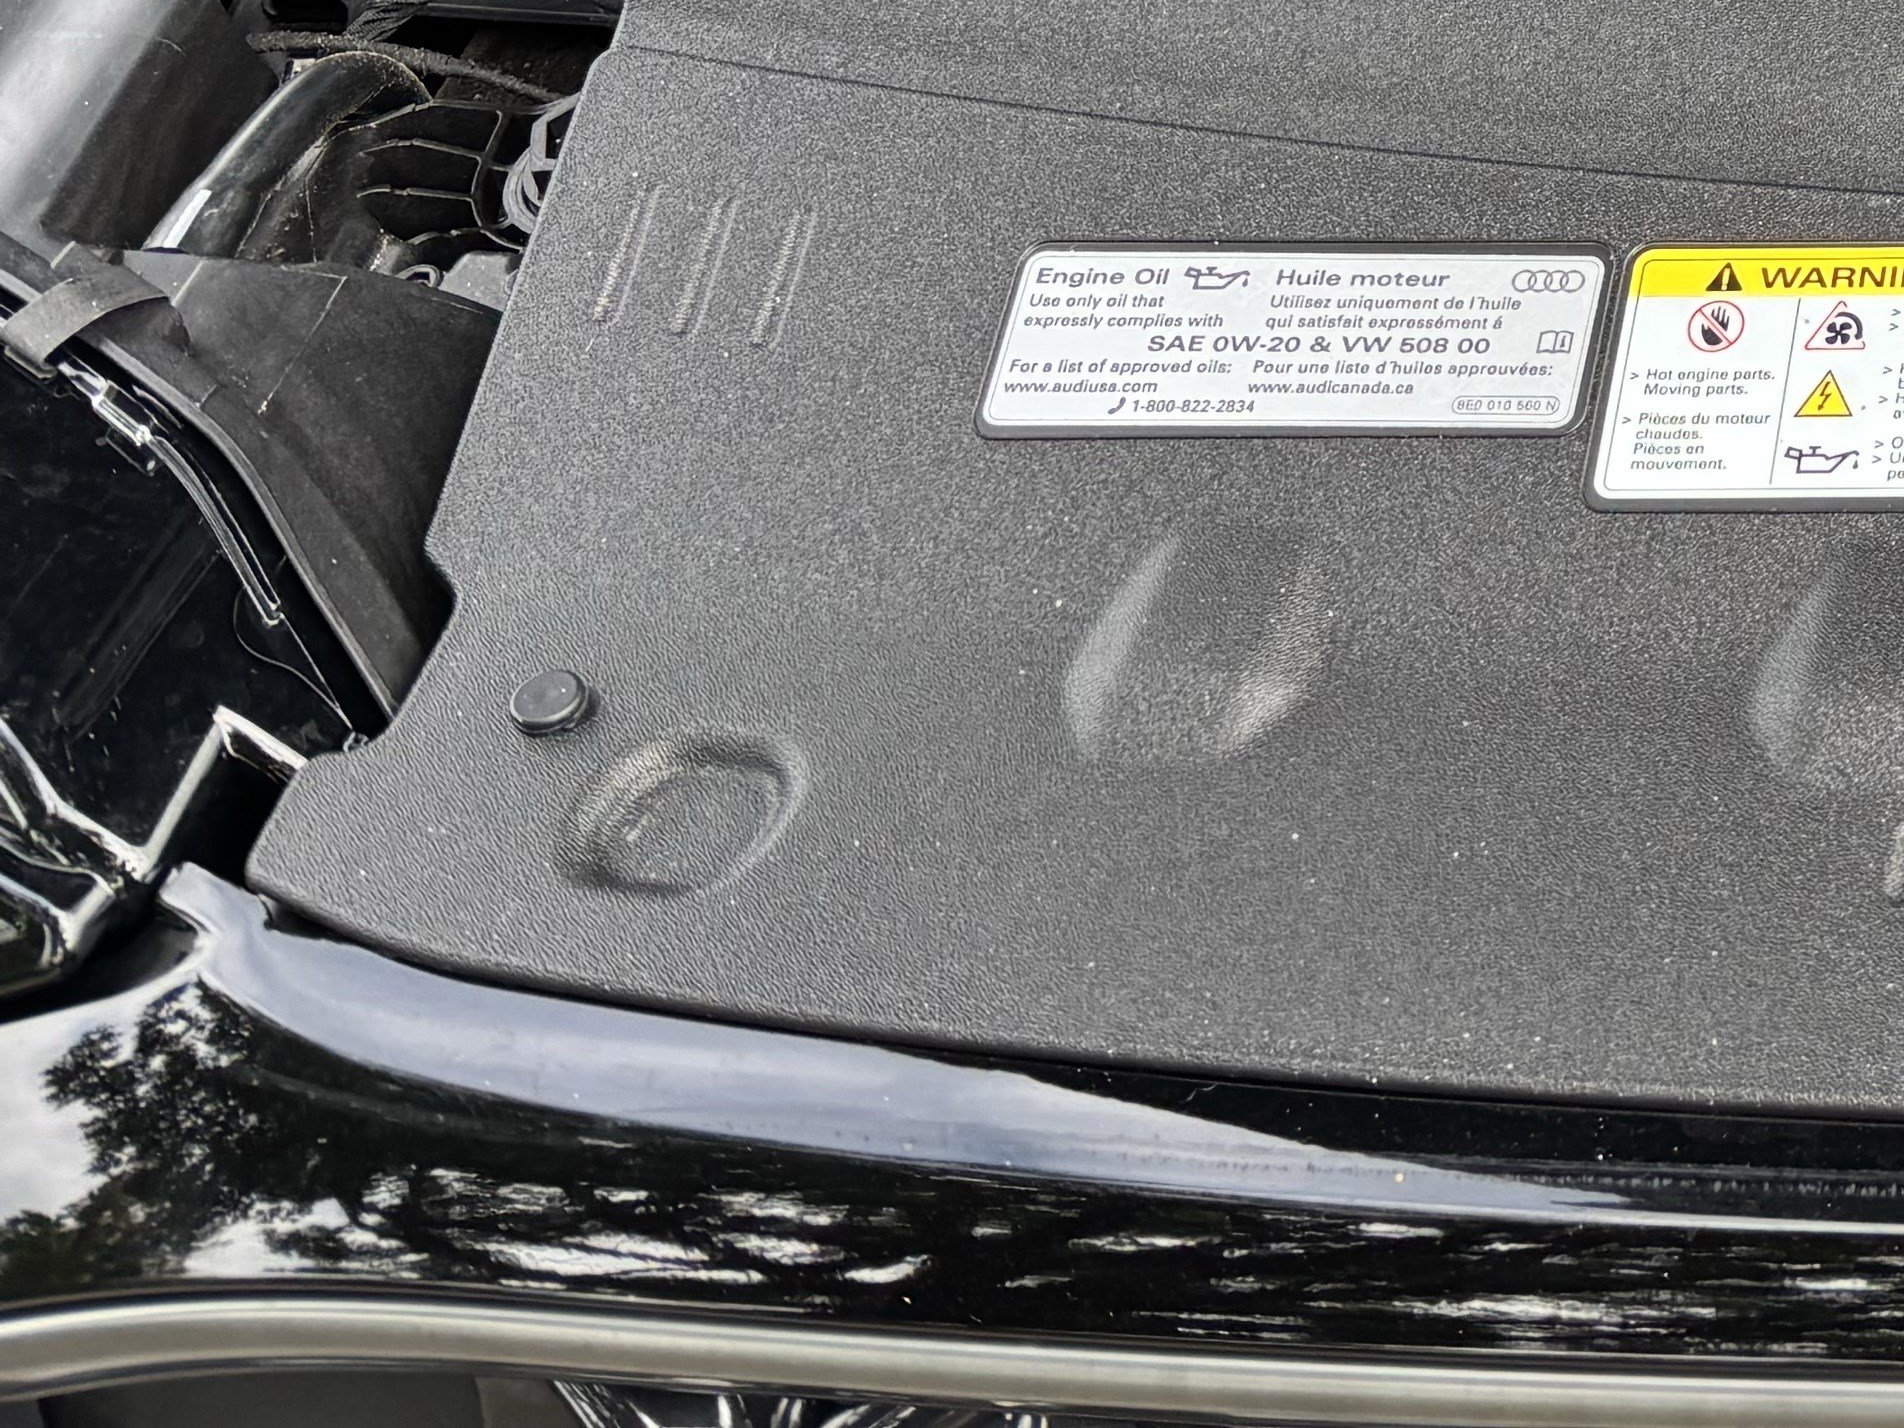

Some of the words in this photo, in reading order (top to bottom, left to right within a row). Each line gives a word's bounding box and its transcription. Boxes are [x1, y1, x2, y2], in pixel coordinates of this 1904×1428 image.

[1035, 267, 1125, 288] Engine
[1134, 268, 1170, 286] Oil
[1275, 269, 1342, 288] Huile
[1350, 273, 1451, 288] moteur
[1029, 293, 1061, 308] Use
[1065, 294, 1102, 310] only
[1106, 293, 1128, 308] oil
[1131, 294, 1165, 308] that
[1270, 295, 1332, 310] Utilisez
[1336, 296, 1440, 312] uniquement
[1443, 297, 1465, 311] de
[1023, 315, 1103, 330] expressly
[1107, 313, 1183, 329] complies
[1188, 313, 1224, 327] with
[1266, 316, 1294, 332] qui
[1297, 315, 1364, 330] satisfait
[1368, 315, 1488, 332] expressément
[1147, 335, 1206, 352] SAE
[1212, 335, 1301, 353] 0W-20
[1309, 337, 1331, 353] &
[1342, 336, 1393, 354] VW
[1398, 337, 1449, 354] 508
[1457, 338, 1491, 354] 00
[1009, 359, 1039, 373] For
[1042, 362, 1053, 373] a
[1057, 359, 1083, 373] list
[1087, 359, 1109, 373] of
[1109, 359, 1193, 376] approved
[1196, 359, 1233, 374] oils:
[1252, 360, 1294, 374] Pour
[1297, 363, 1329, 374] une
[1334, 360, 1370, 375] liste
[1447, 362, 1554, 378] approuvées:
[1646, 368, 1673, 381] Hot
[1677, 368, 1729, 382] engine
[1733, 369, 1776, 382] parts.
[1004, 380, 1158, 393] www.audiusa.com
[1248, 381, 1414, 395] www.audicanada.ca
[1644, 383, 1701, 398] Moving
[1705, 384, 1749, 397] parts.
[1132, 399, 1255, 413] 1-800-822-2834
[1487, 399, 1511, 411] 010
[1546, 400, 1556, 412] N
[1639, 412, 1686, 425] Pièces
[1691, 412, 1710, 425] du
[1715, 414, 1771, 425] moteur
[1635, 428, 1703, 440] chaudes.
[1685, 444, 1705, 455] en
[1630, 459, 1728, 470] mouvement.
